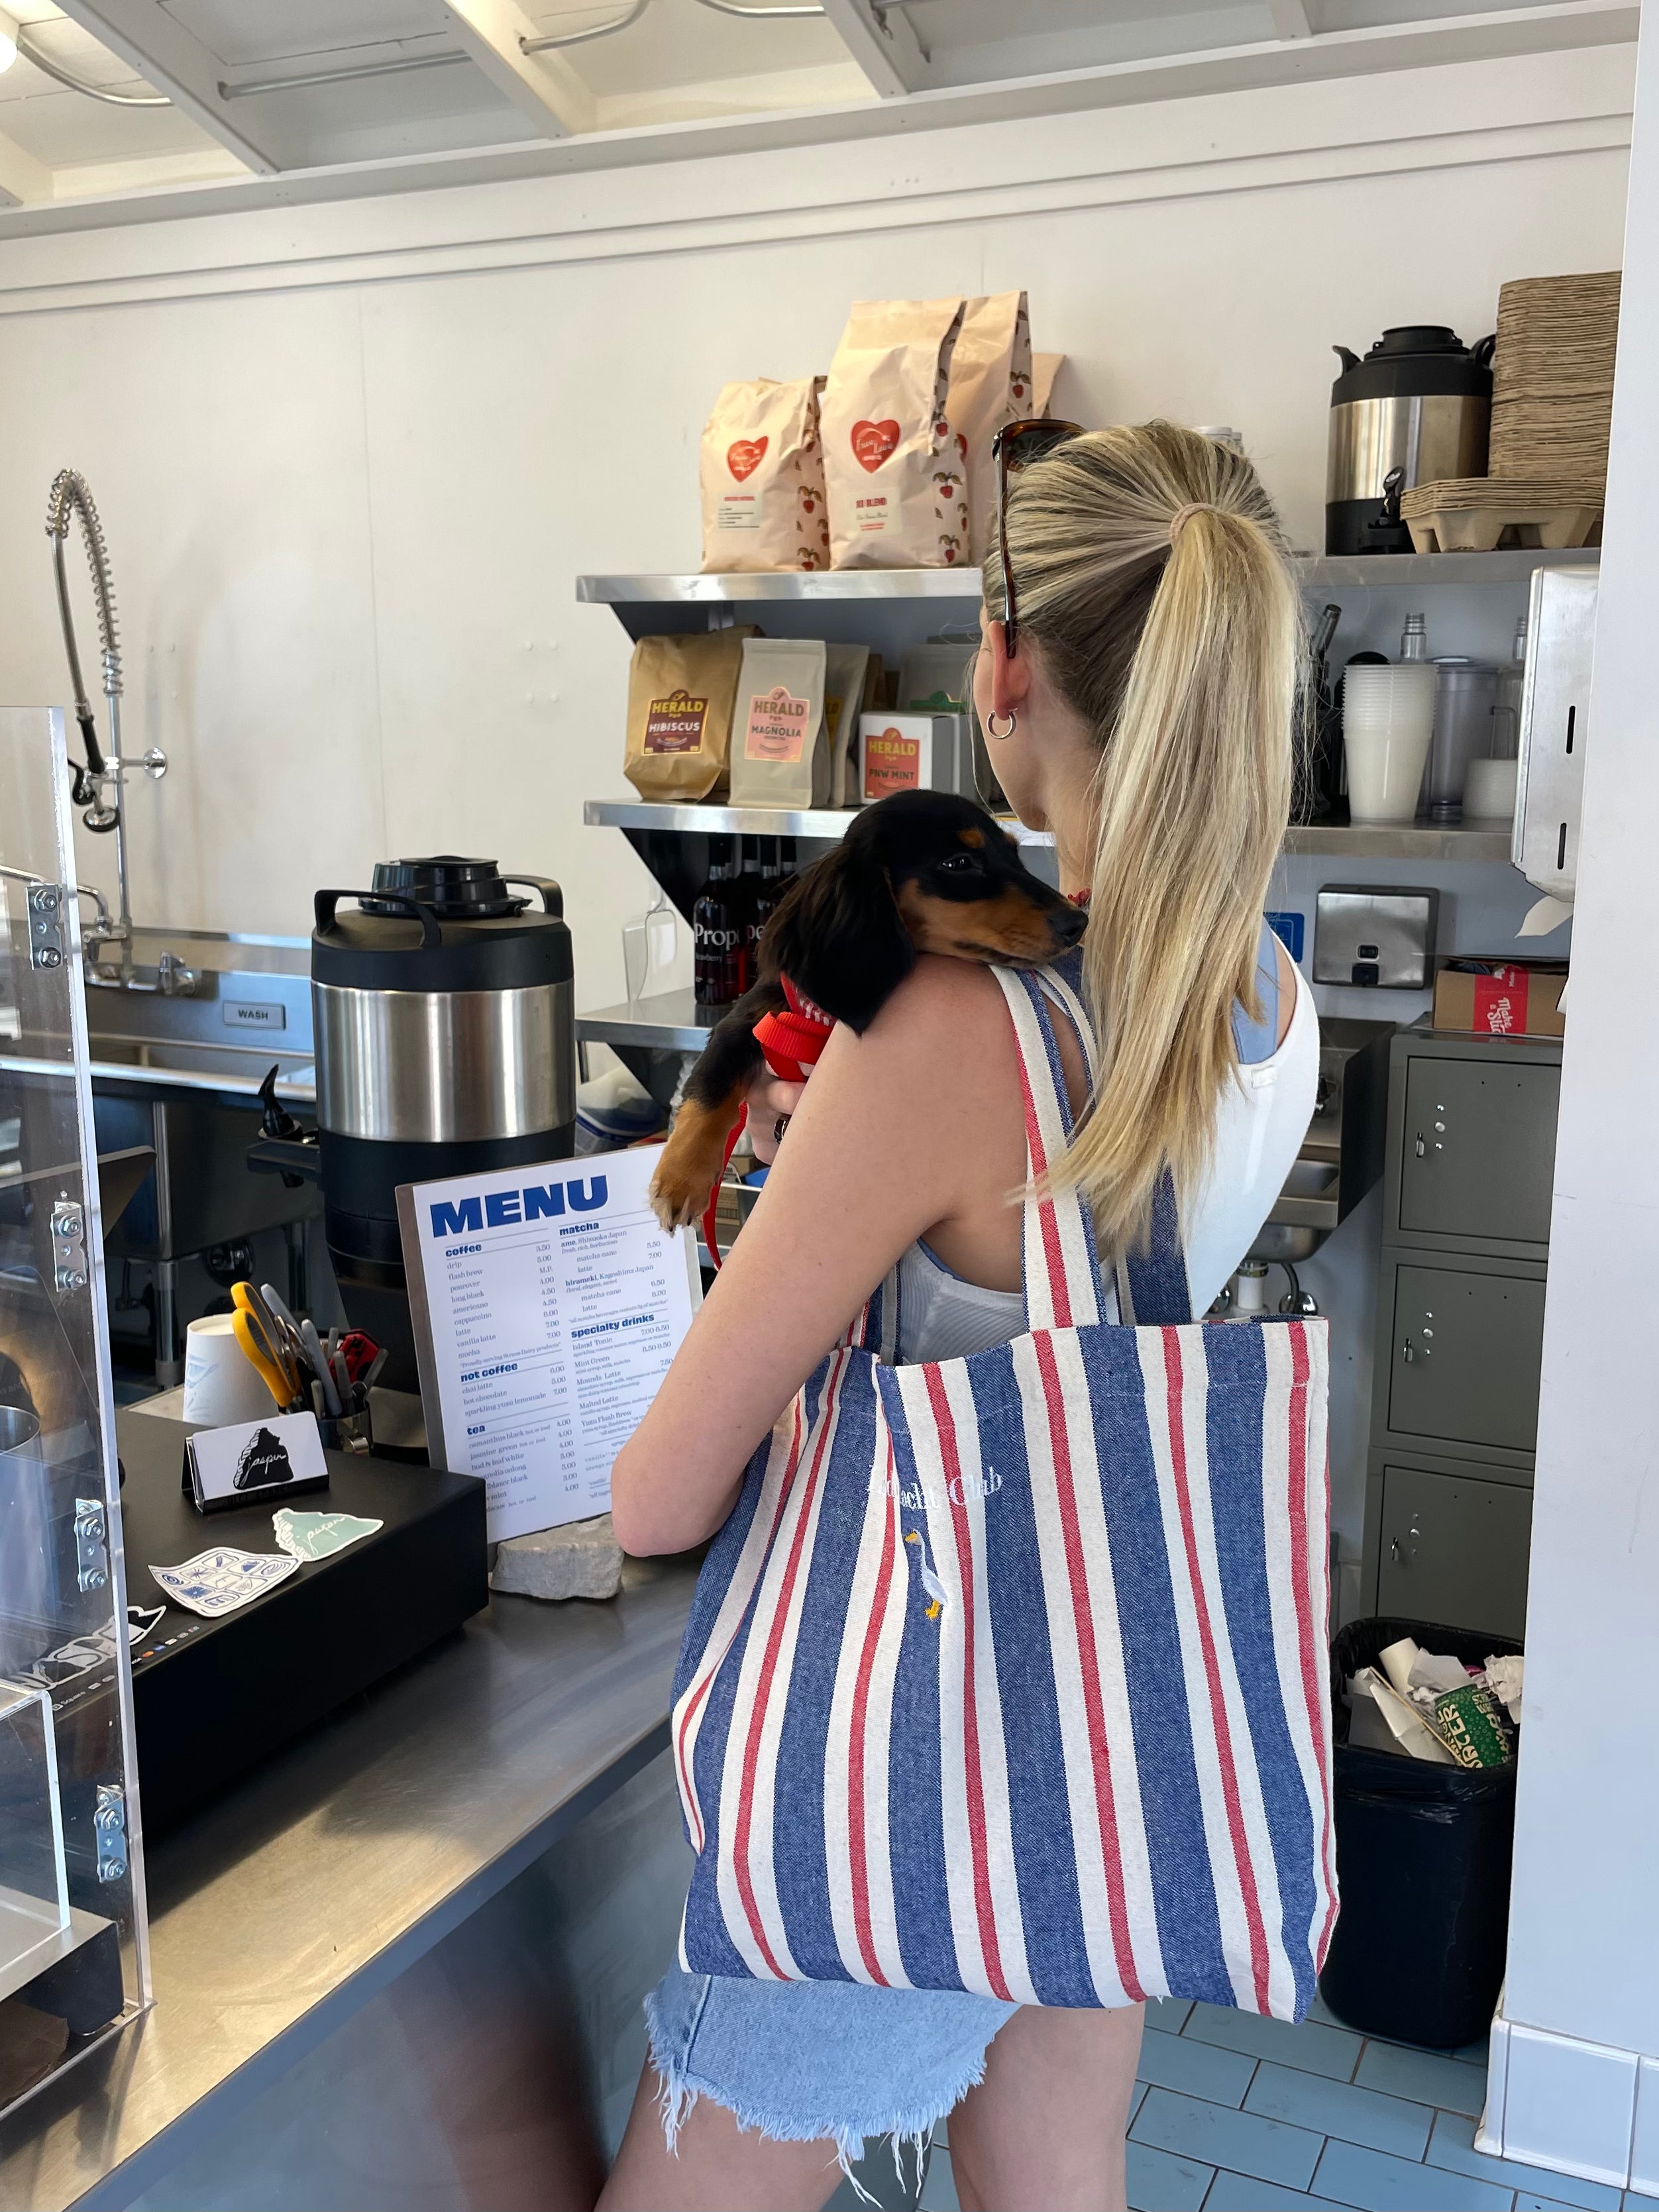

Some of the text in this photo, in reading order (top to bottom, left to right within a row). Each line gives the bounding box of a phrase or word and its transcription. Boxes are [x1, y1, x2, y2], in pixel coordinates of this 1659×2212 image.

[652, 701, 704, 713] HERALD
[754, 701, 804, 717] HERALD
[649, 722, 700, 732] HIBISCUS
[751, 725, 802, 737] MAGNOLIA
[869, 741, 916, 757] HERALD
[892, 771, 915, 780] MINT
[239, 1009, 268, 1020] WASH
[429, 1175, 608, 1238] MENU
[560, 1223, 599, 1236] matcha
[446, 1244, 482, 1257] coffee
[576, 1253, 600, 1262] matcha
[447, 1261, 462, 1270] drip
[451, 1281, 480, 1293] pourover
[452, 1290, 484, 1303] long black
[581, 1292, 605, 1301] matcha
[453, 1302, 488, 1314] americano
[454, 1313, 492, 1325] cappuccino
[571, 1314, 654, 1338] specialty drinks
[457, 1338, 480, 1347] vanilla
[573, 1341, 592, 1350] Island
[458, 1349, 480, 1358] mocha
[461, 1363, 518, 1382] not coffee
[462, 1385, 476, 1394] chai
[476, 1391, 507, 1402] chocolate
[465, 1404, 496, 1416] sparkling
[515, 1393, 546, 1404] lemonade
[579, 1396, 618, 1410] Malted Latte
[598, 1414, 615, 1423] Flash
[467, 1425, 485, 1435] tea
[506, 1430, 523, 1440] black
[470, 1448, 496, 1461] jasmine
[498, 1444, 517, 1453] green
[472, 1462, 484, 1471] bud
[492, 1457, 504, 1466] leaf
[506, 1453, 524, 1463] white
[505, 1464, 526, 1473] oolong
[949, 1465, 1004, 1506] Club
[492, 1491, 507, 1500] mint
